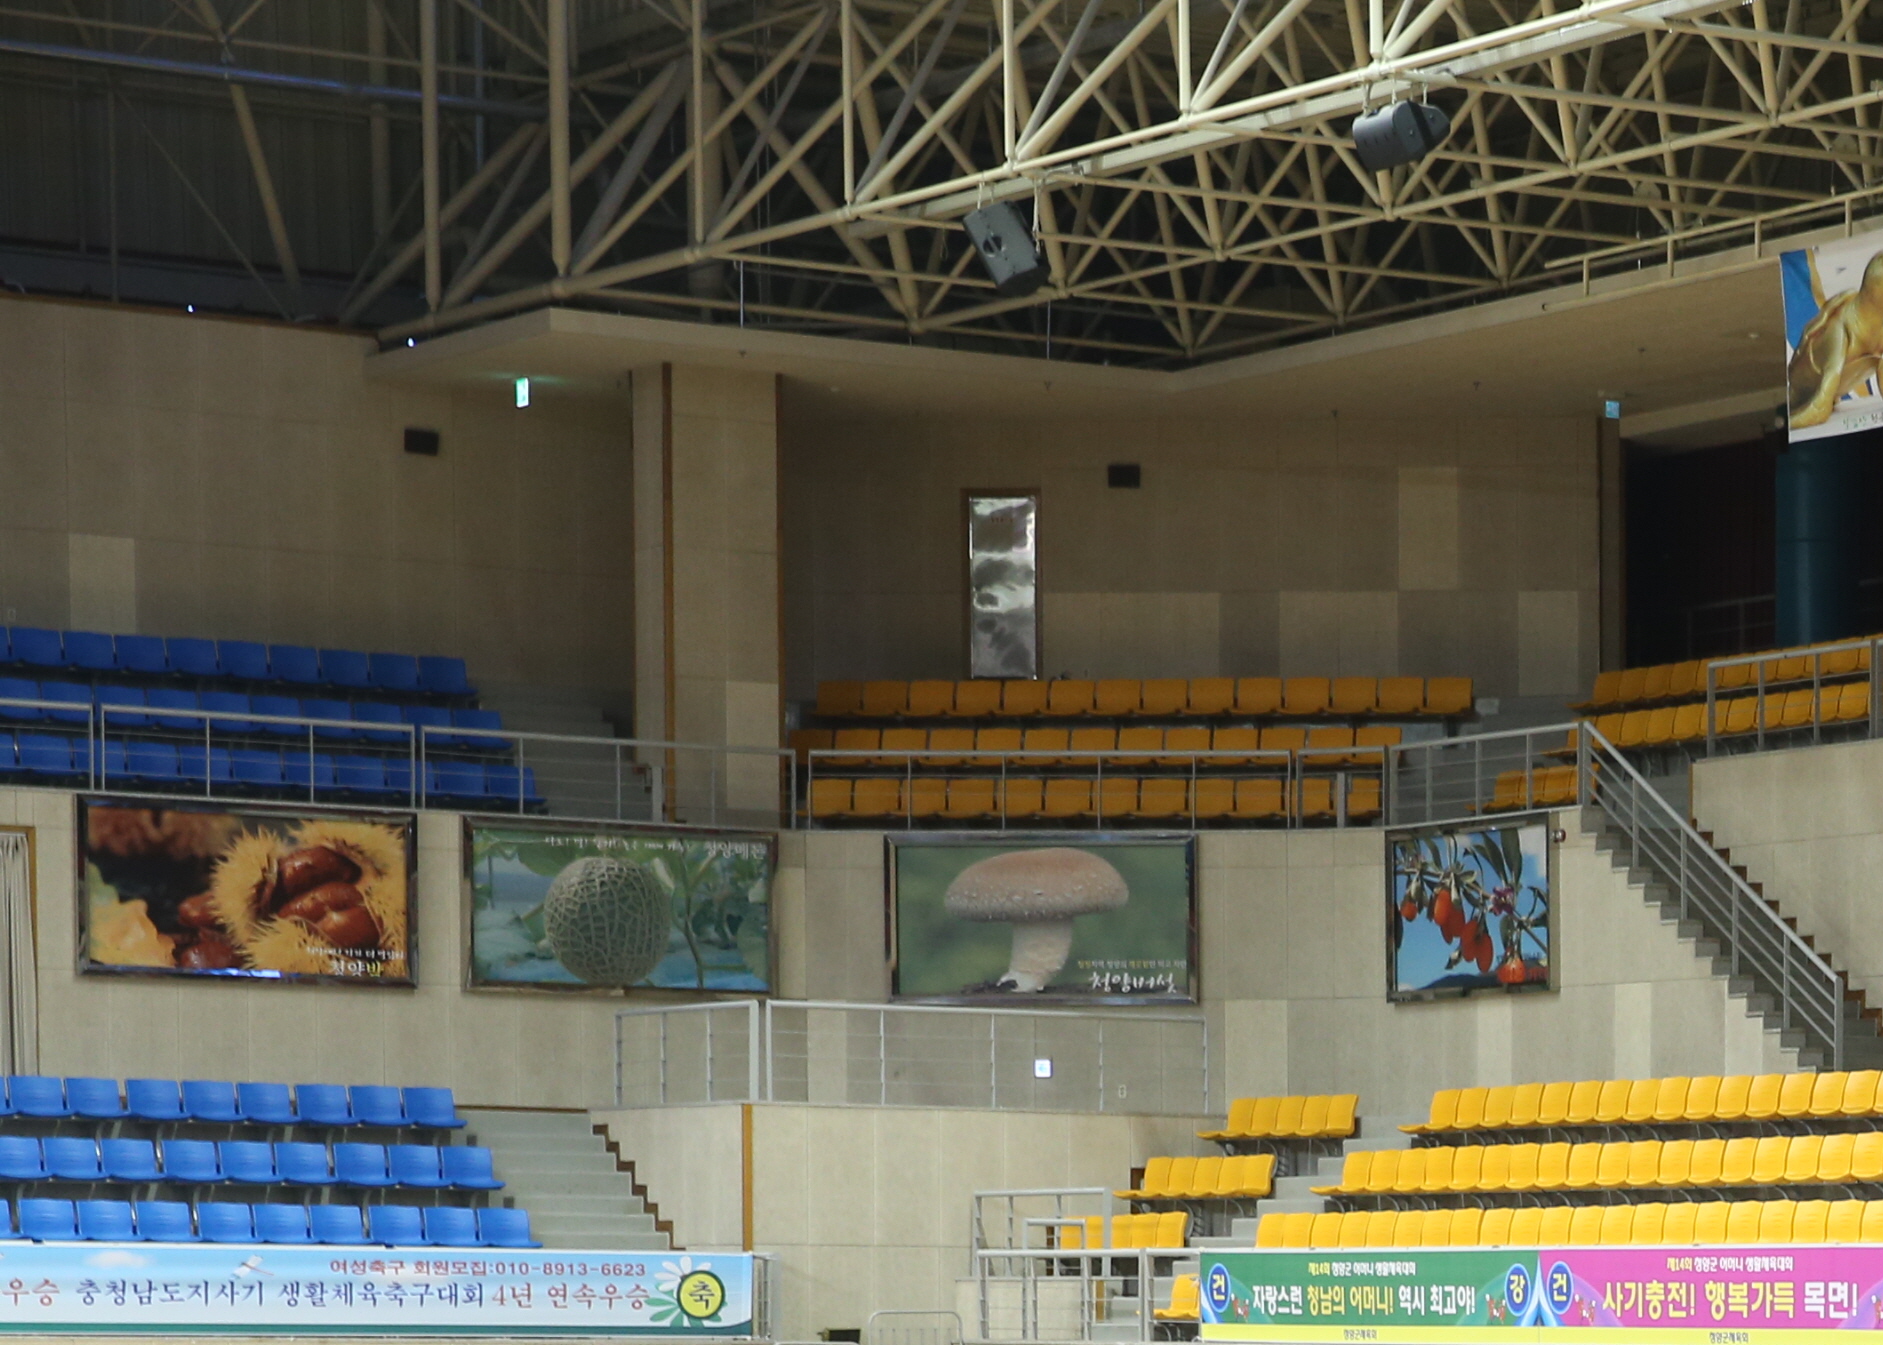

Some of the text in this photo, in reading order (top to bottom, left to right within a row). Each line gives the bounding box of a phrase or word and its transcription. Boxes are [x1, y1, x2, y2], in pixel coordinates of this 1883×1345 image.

[1089, 971, 1177, 993] 청양버섯
[329, 1258, 406, 1276] 여성축구
[1308, 1261, 1416, 1276] 제14회 청양군 어머니 생활체육대회
[1667, 1257, 1794, 1272] 제14회 청양군 어머니 생활체육대회
[2, 1277, 652, 1311] 우승 충청남도지사기 생활체육축구대회 4년 연속우승
[687, 1279, 715, 1310] 축
[1212, 1273, 1226, 1300] 건
[1509, 1275, 1526, 1304] 강
[1551, 1273, 1568, 1302] 건
[1602, 1279, 1858, 1321] 사기충전! 행복가득 목면!
[1252, 1285, 1475, 1316] 자랑스런 청남의 어머니! 역시 최고야!
[1343, 1329, 1378, 1341] 청양군체육회
[1709, 1331, 1750, 1344] 청양군체육회
